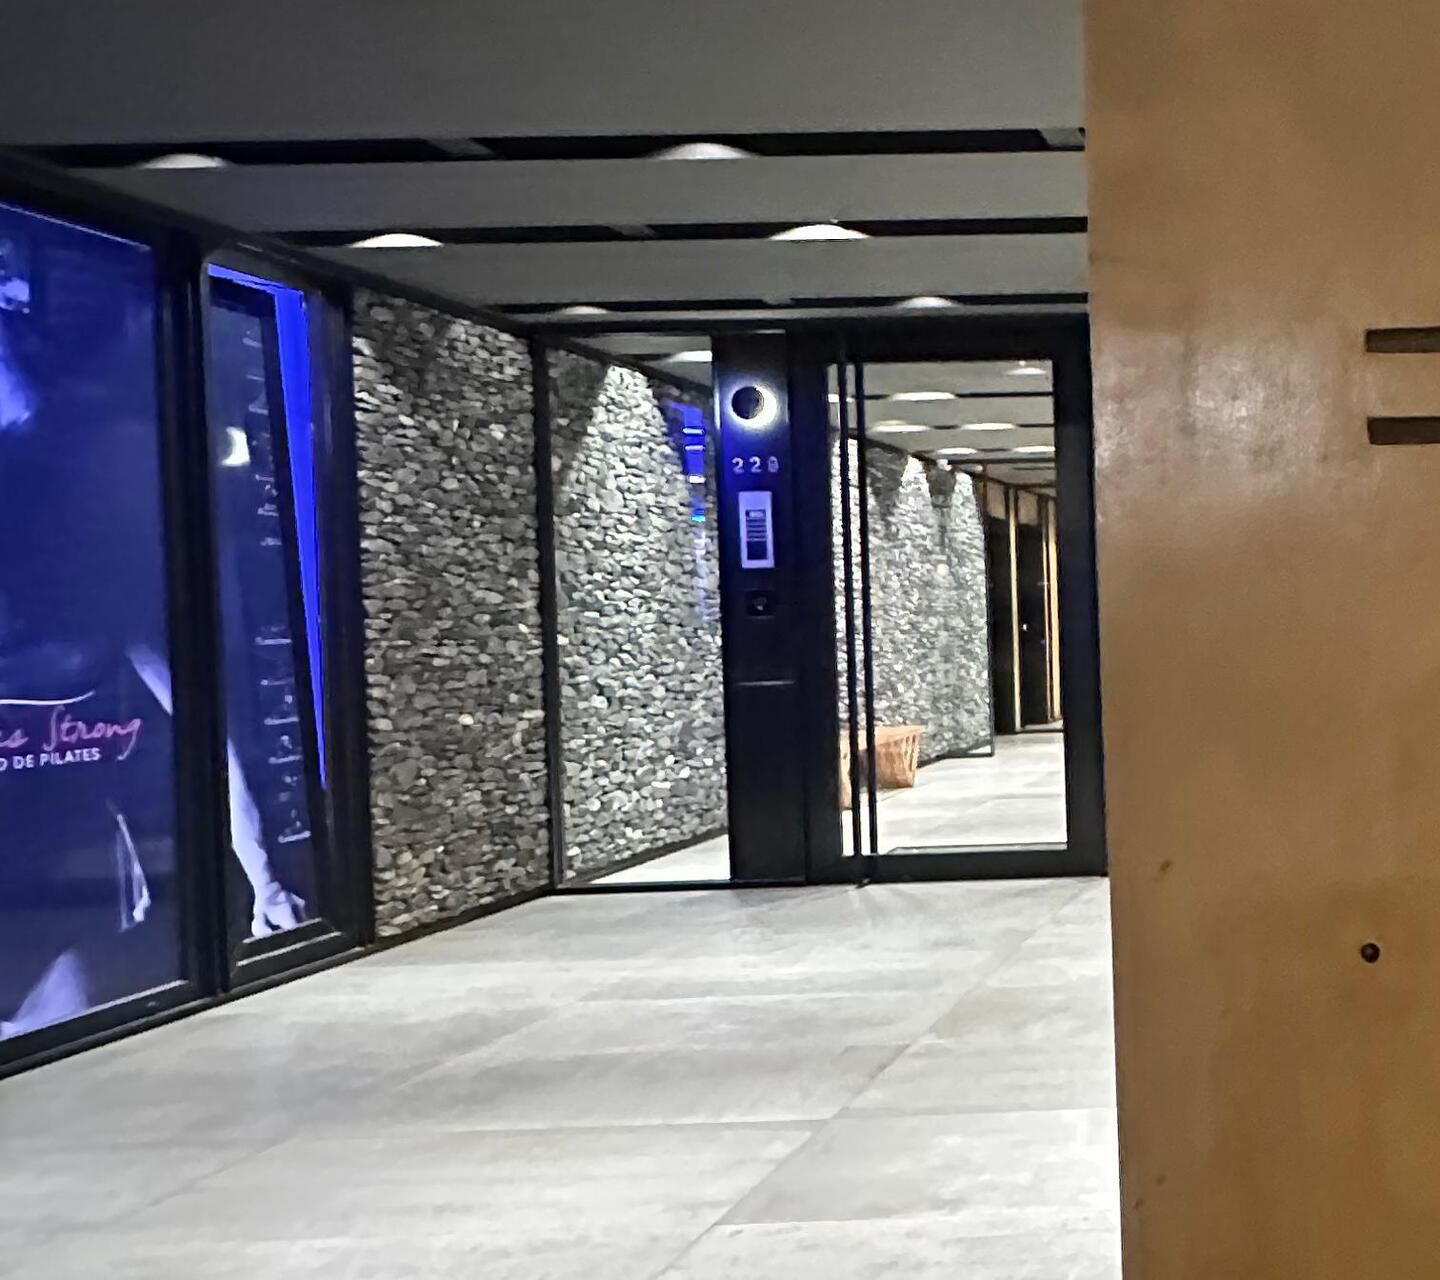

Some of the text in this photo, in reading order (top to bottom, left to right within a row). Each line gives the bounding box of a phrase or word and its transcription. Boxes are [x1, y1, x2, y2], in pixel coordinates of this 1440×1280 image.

[42, 705, 142, 760] Strong
[12, 754, 35, 770] DE
[40, 747, 101, 767] PILATES
